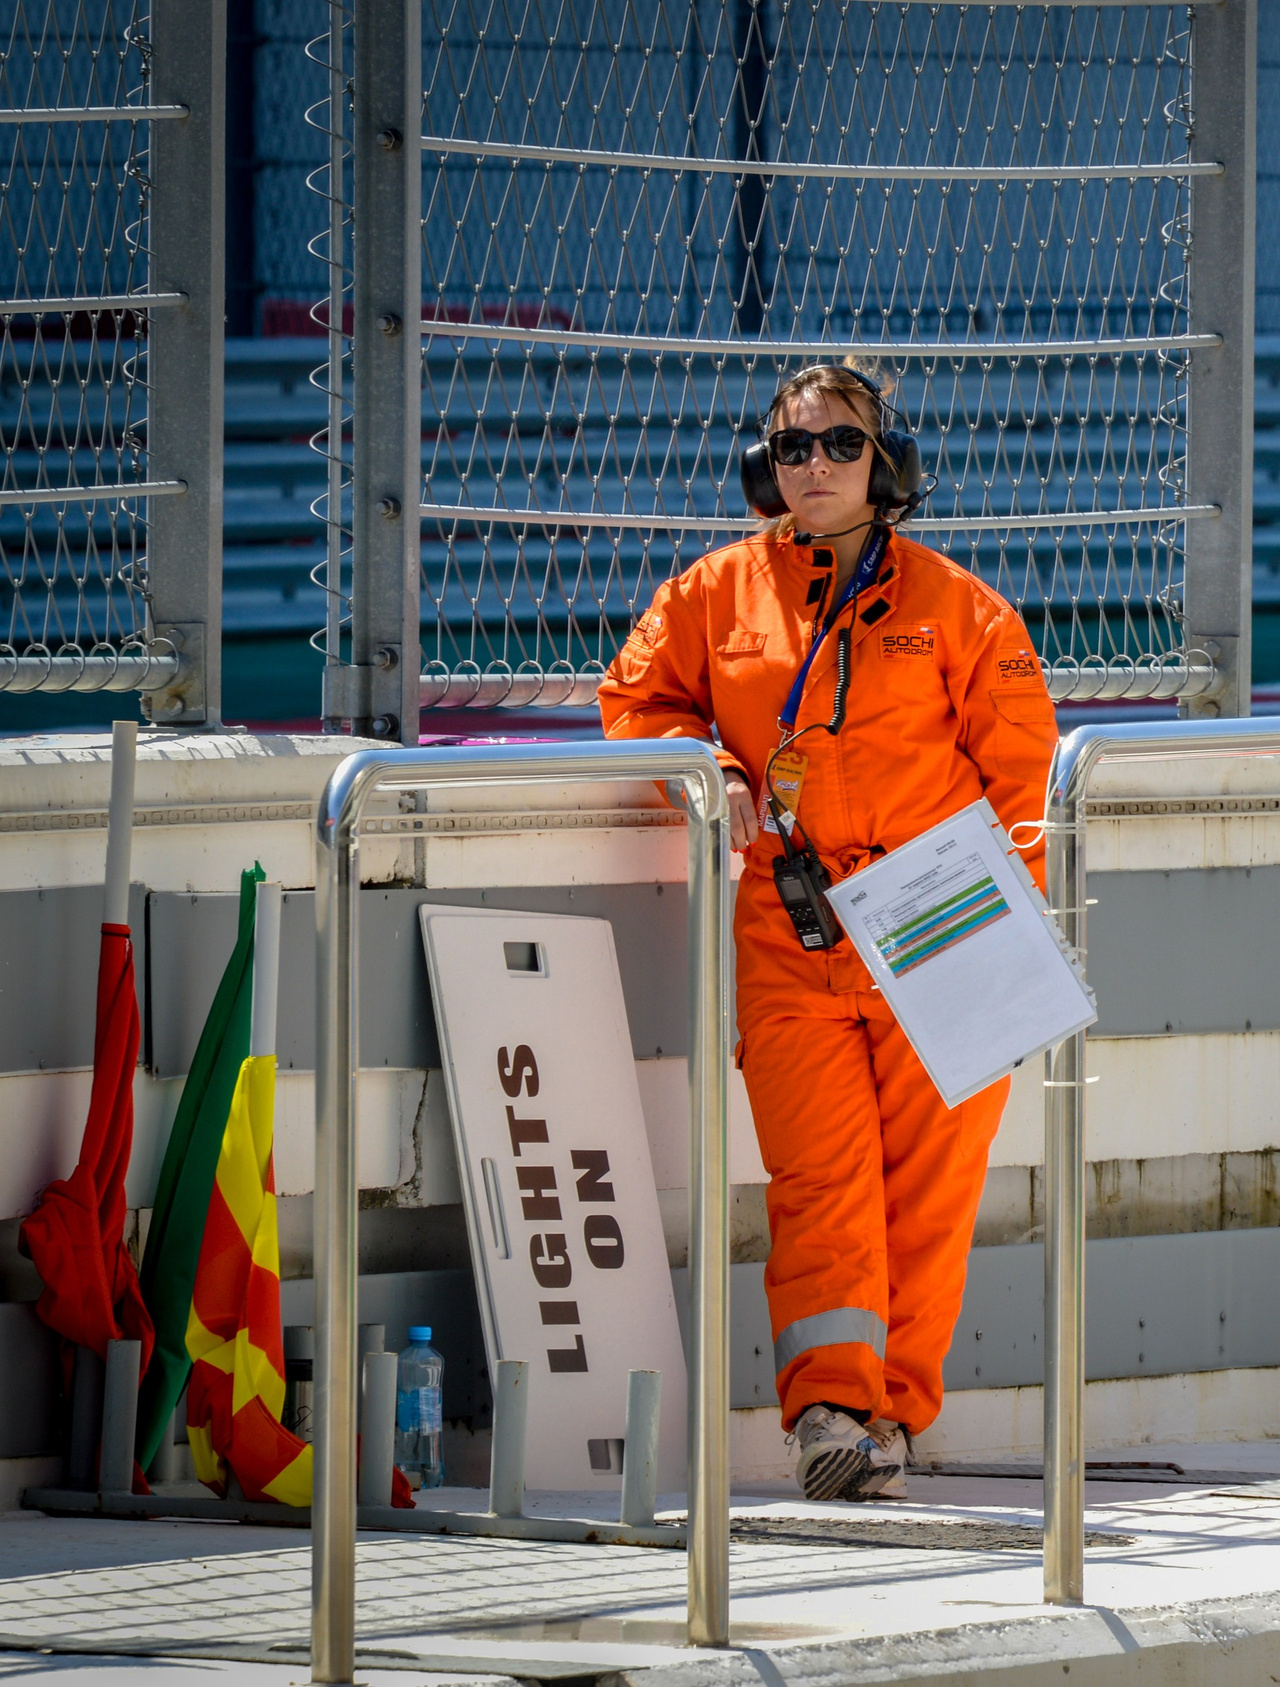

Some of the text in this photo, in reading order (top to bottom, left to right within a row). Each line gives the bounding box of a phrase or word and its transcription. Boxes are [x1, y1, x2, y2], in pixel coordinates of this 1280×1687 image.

[867, 550, 877, 566] SMP
[882, 635, 934, 649] SOCHI
[883, 647, 933, 656] AUTODROM
[998, 659, 1035, 672] SOCHI
[1001, 670, 1038, 679] AUTODROM
[497, 1043, 589, 1374] LIGHTS
[570, 1149, 625, 1270] ON
